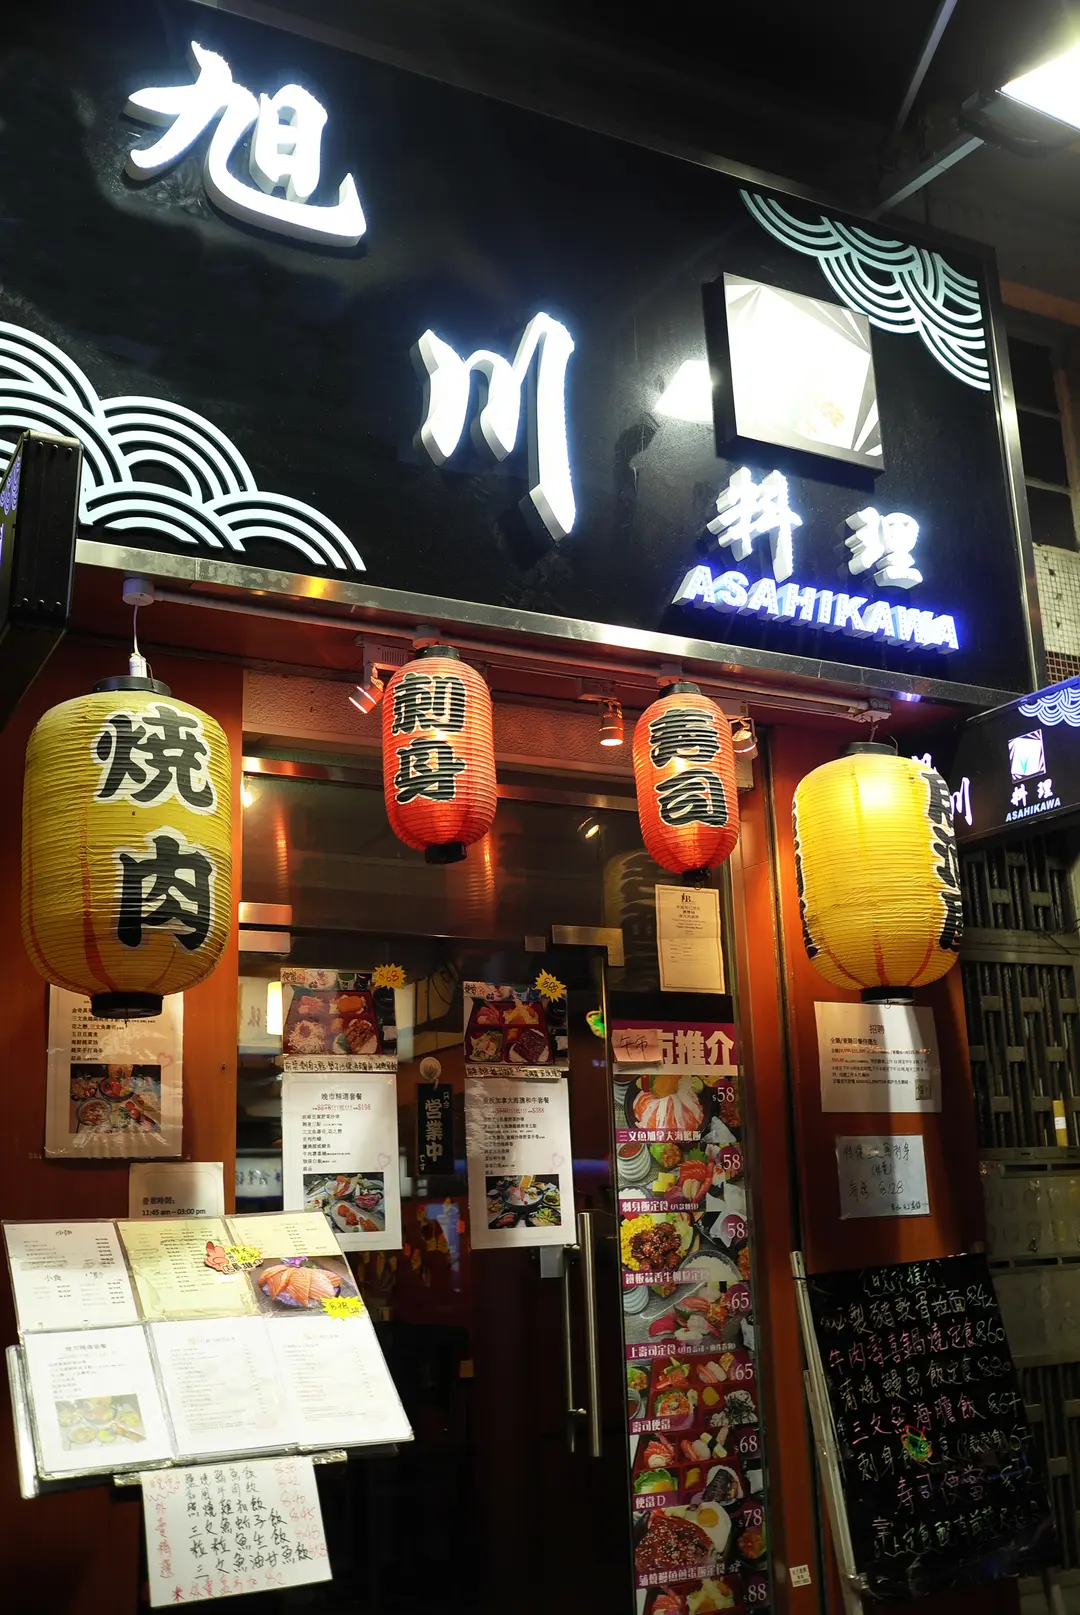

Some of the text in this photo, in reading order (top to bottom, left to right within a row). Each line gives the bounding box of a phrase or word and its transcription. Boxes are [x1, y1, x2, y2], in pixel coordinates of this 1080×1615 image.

[123, 40, 367, 247] 旭
[411, 311, 577, 541] 川
[671, 564, 960, 655] ASAHIKAWA
[1005, 797, 1061, 822] ASAHIKAWA
[142, 1208, 160, 1216] 11:45
[177, 1208, 195, 1216] 03:00
[195, 1208, 206, 1217] pm
